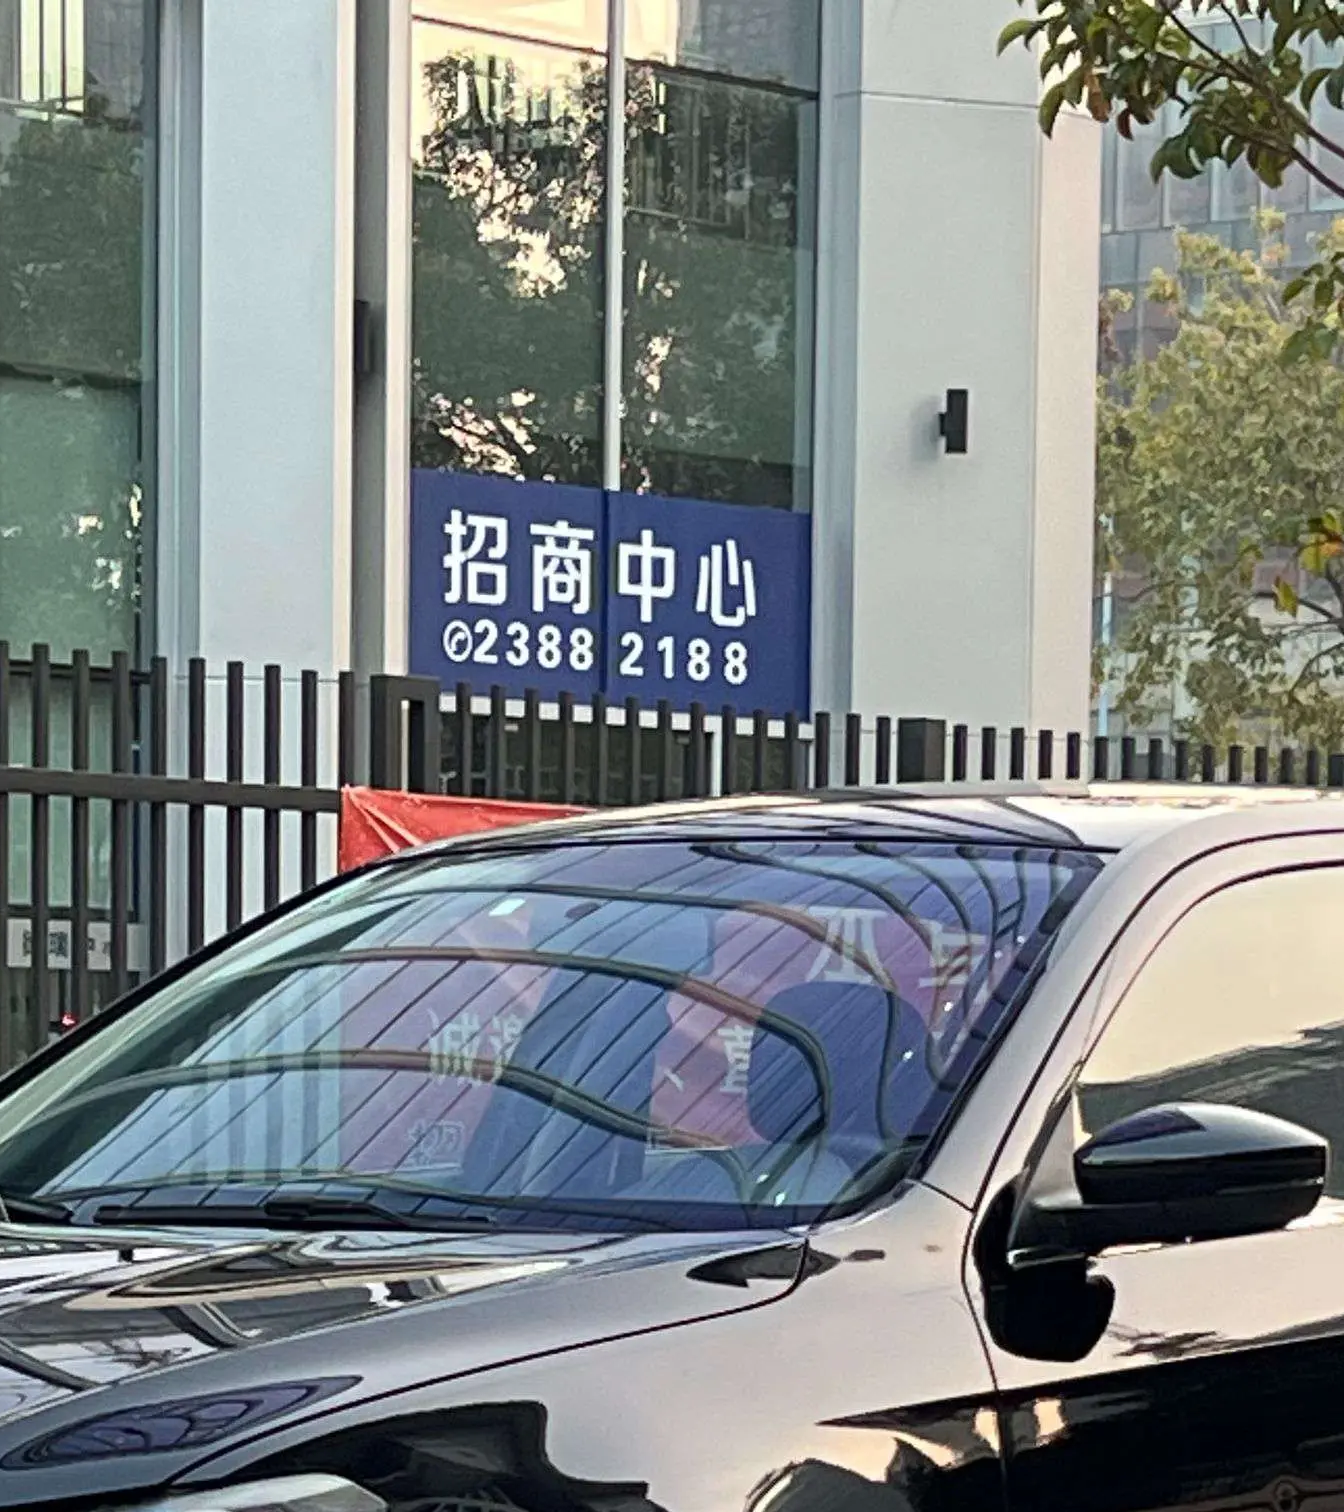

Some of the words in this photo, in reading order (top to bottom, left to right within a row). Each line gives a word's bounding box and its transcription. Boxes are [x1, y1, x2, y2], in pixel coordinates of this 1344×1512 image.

[443, 509, 757, 627] 招商中心
[474, 619, 596, 671] 2388
[620, 632, 749, 685] 2188
